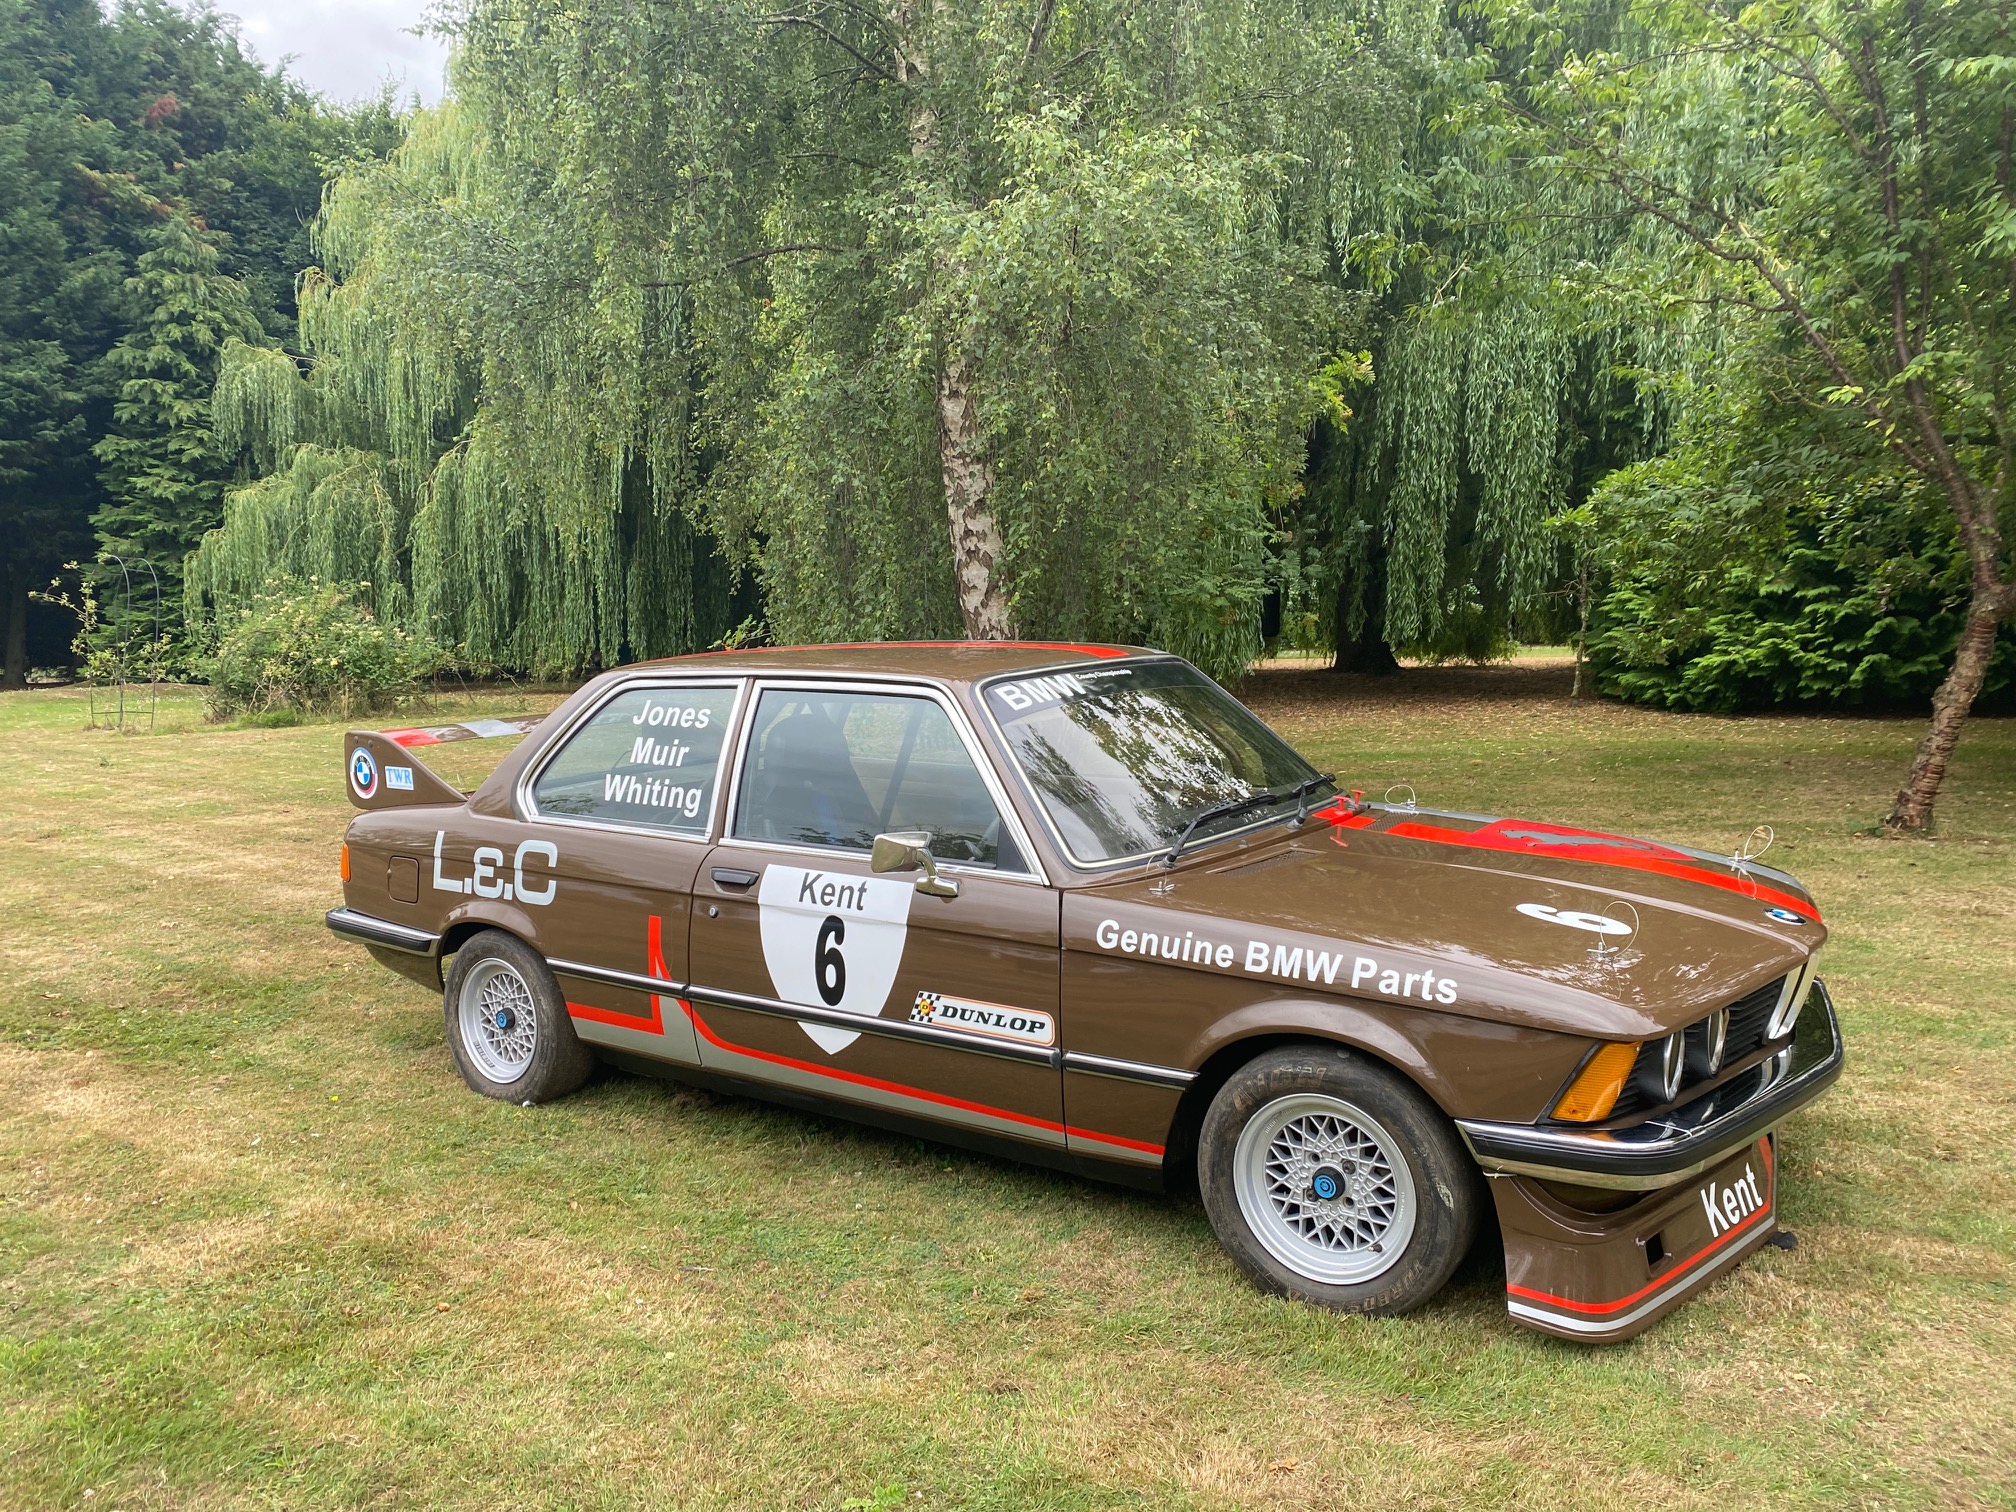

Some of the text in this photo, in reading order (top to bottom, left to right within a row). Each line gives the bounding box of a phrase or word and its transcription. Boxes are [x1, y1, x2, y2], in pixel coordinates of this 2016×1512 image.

[994, 673, 1087, 711] BMW
[632, 700, 711, 729] Jones
[630, 737, 690, 767] Muir
[386, 768, 412, 785] TWR
[604, 774, 702, 818] Whiting
[798, 872, 867, 911] Kent
[815, 915, 846, 1006] 6
[1095, 919, 1458, 1004] Genuine BMW Parts
[939, 1004, 1046, 1033] DUNLOP
[1700, 1162, 1763, 1238] Kent
